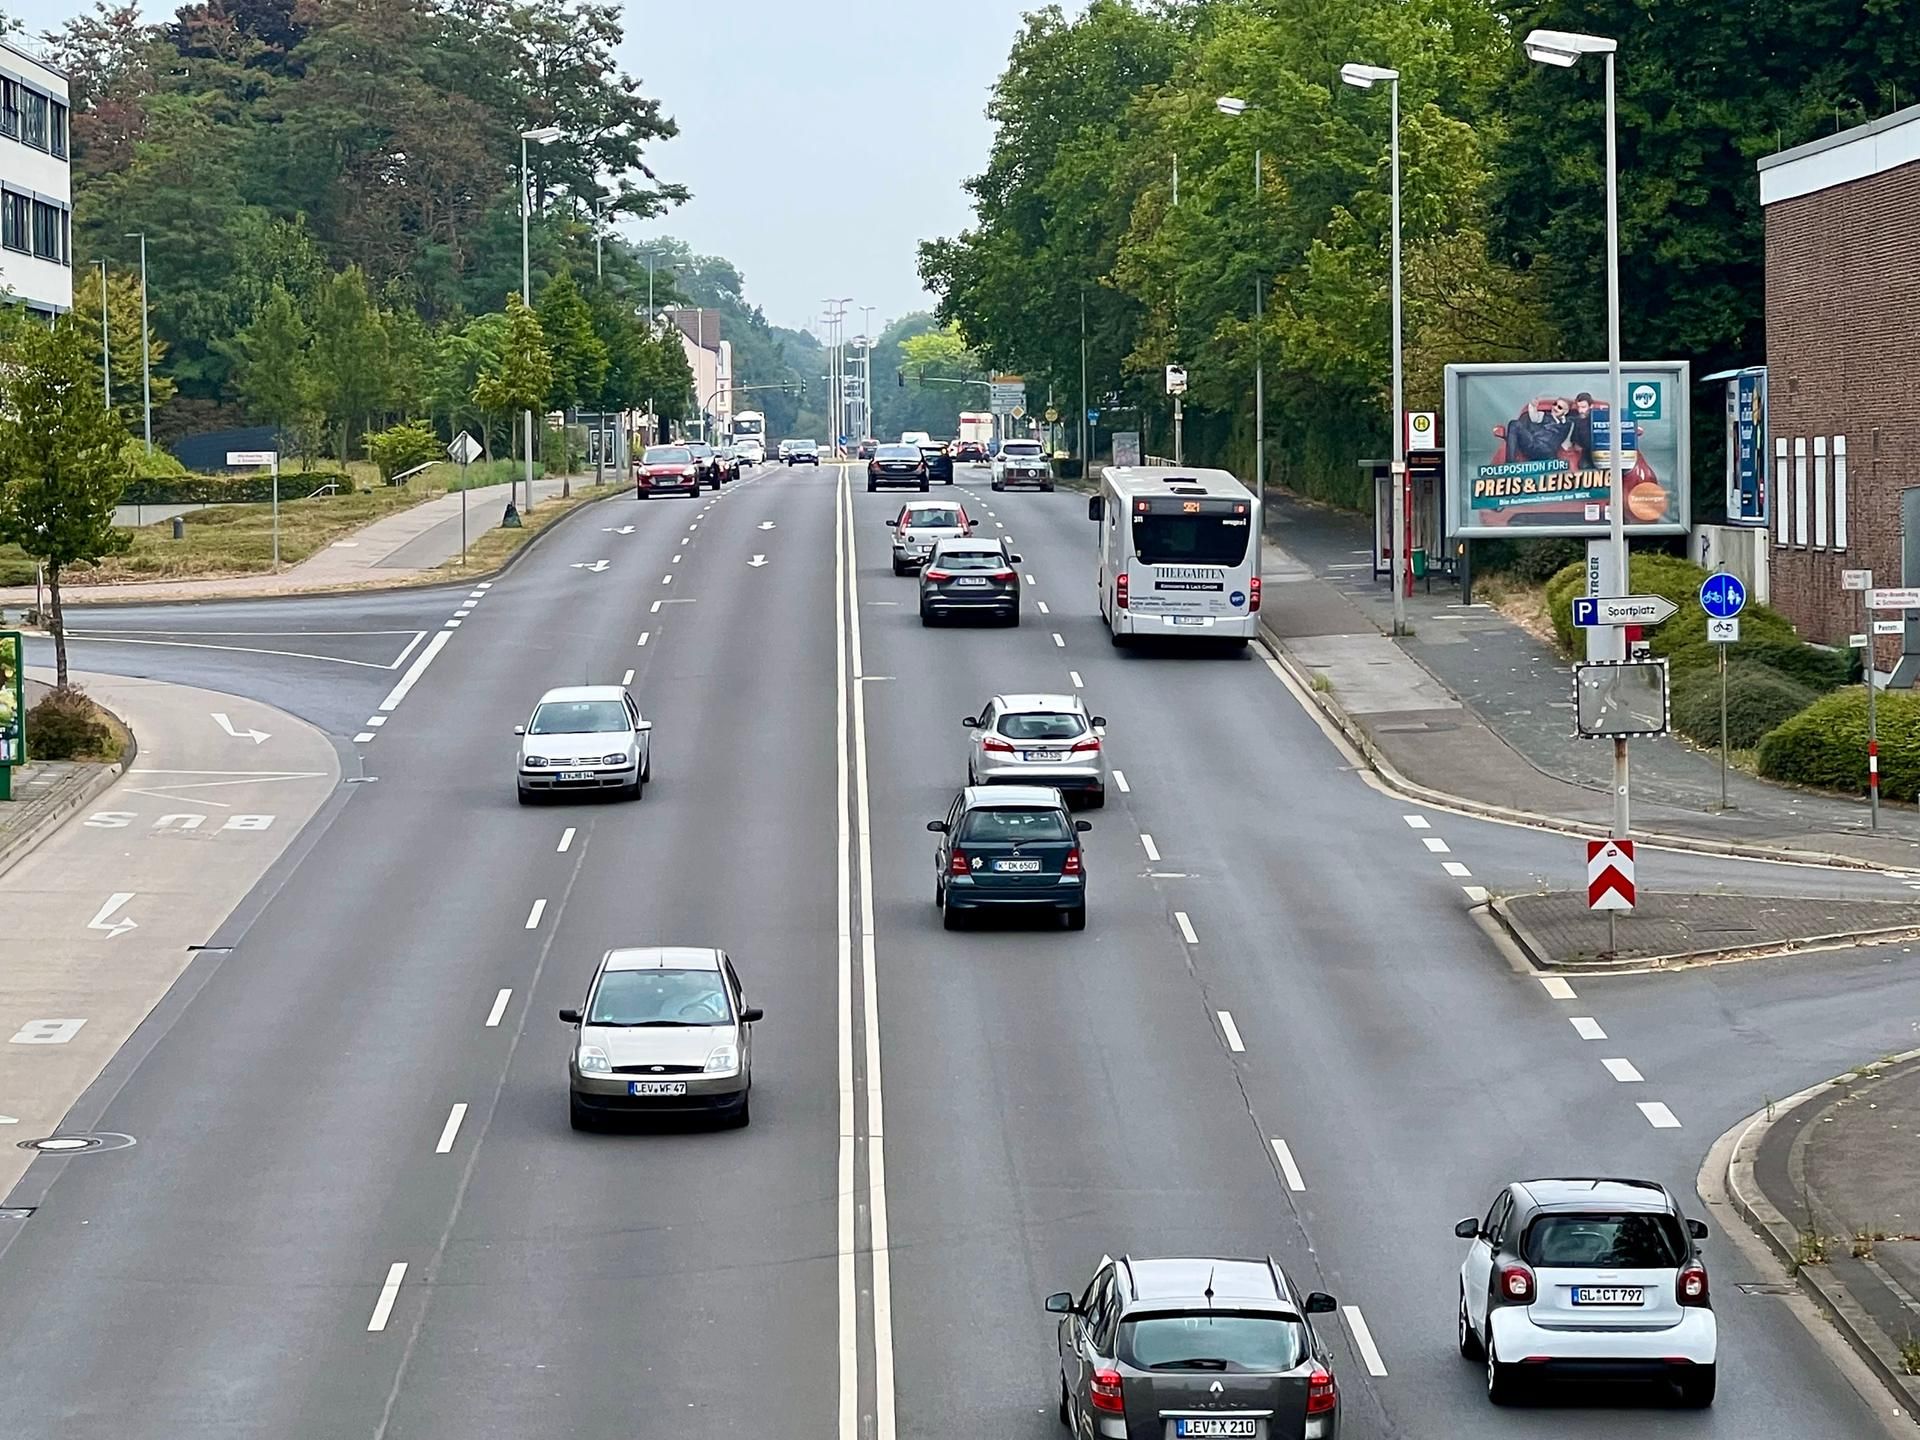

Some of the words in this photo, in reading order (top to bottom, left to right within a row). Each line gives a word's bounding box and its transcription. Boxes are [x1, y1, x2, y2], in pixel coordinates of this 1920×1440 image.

[1480, 461, 1546, 476] POLEPOSITION
[1548, 459, 1569, 472] FÜR:
[1474, 476, 1522, 497] PREIS
[1523, 477, 1537, 493] &
[1155, 567, 1225, 580] THEEGARTEN
[1578, 602, 1592, 622] P
[1607, 605, 1656, 618] Sportplatz
[635, 1083, 654, 1093] LEV
[659, 1083, 671, 1093] WF
[673, 1083, 685, 1093] 47
[1580, 1289, 1595, 1301] GL
[1603, 1289, 1618, 1301] CT
[1620, 1289, 1642, 1301] 797
[1185, 1421, 1209, 1433] LEV
[1219, 1421, 1227, 1433] X
[1230, 1420, 1254, 1433] 210
